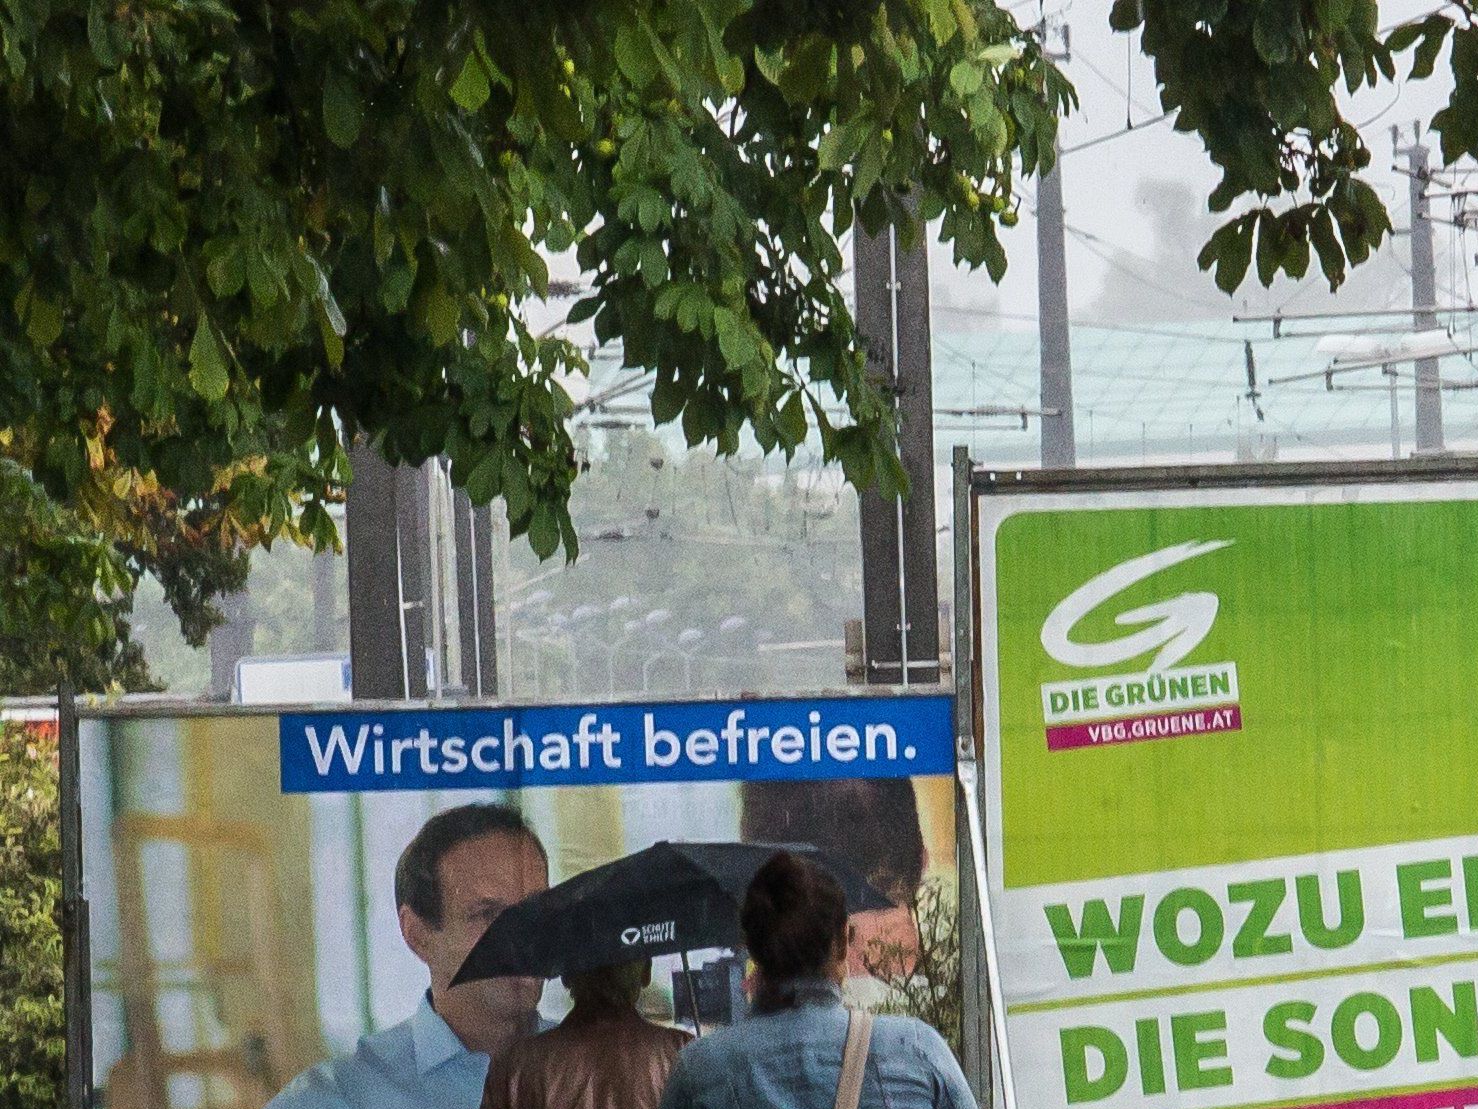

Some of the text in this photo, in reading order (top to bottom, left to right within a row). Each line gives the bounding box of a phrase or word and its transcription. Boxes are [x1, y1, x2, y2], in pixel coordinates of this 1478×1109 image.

[1050, 671, 1230, 716] DIE GRÜNEN
[1088, 709, 1234, 742] VBG.GRUENE.AT
[304, 709, 917, 776] Wirtschaft befreien.
[1043, 868, 1366, 982] WOZU
[1059, 1009, 1235, 1106] DIE
